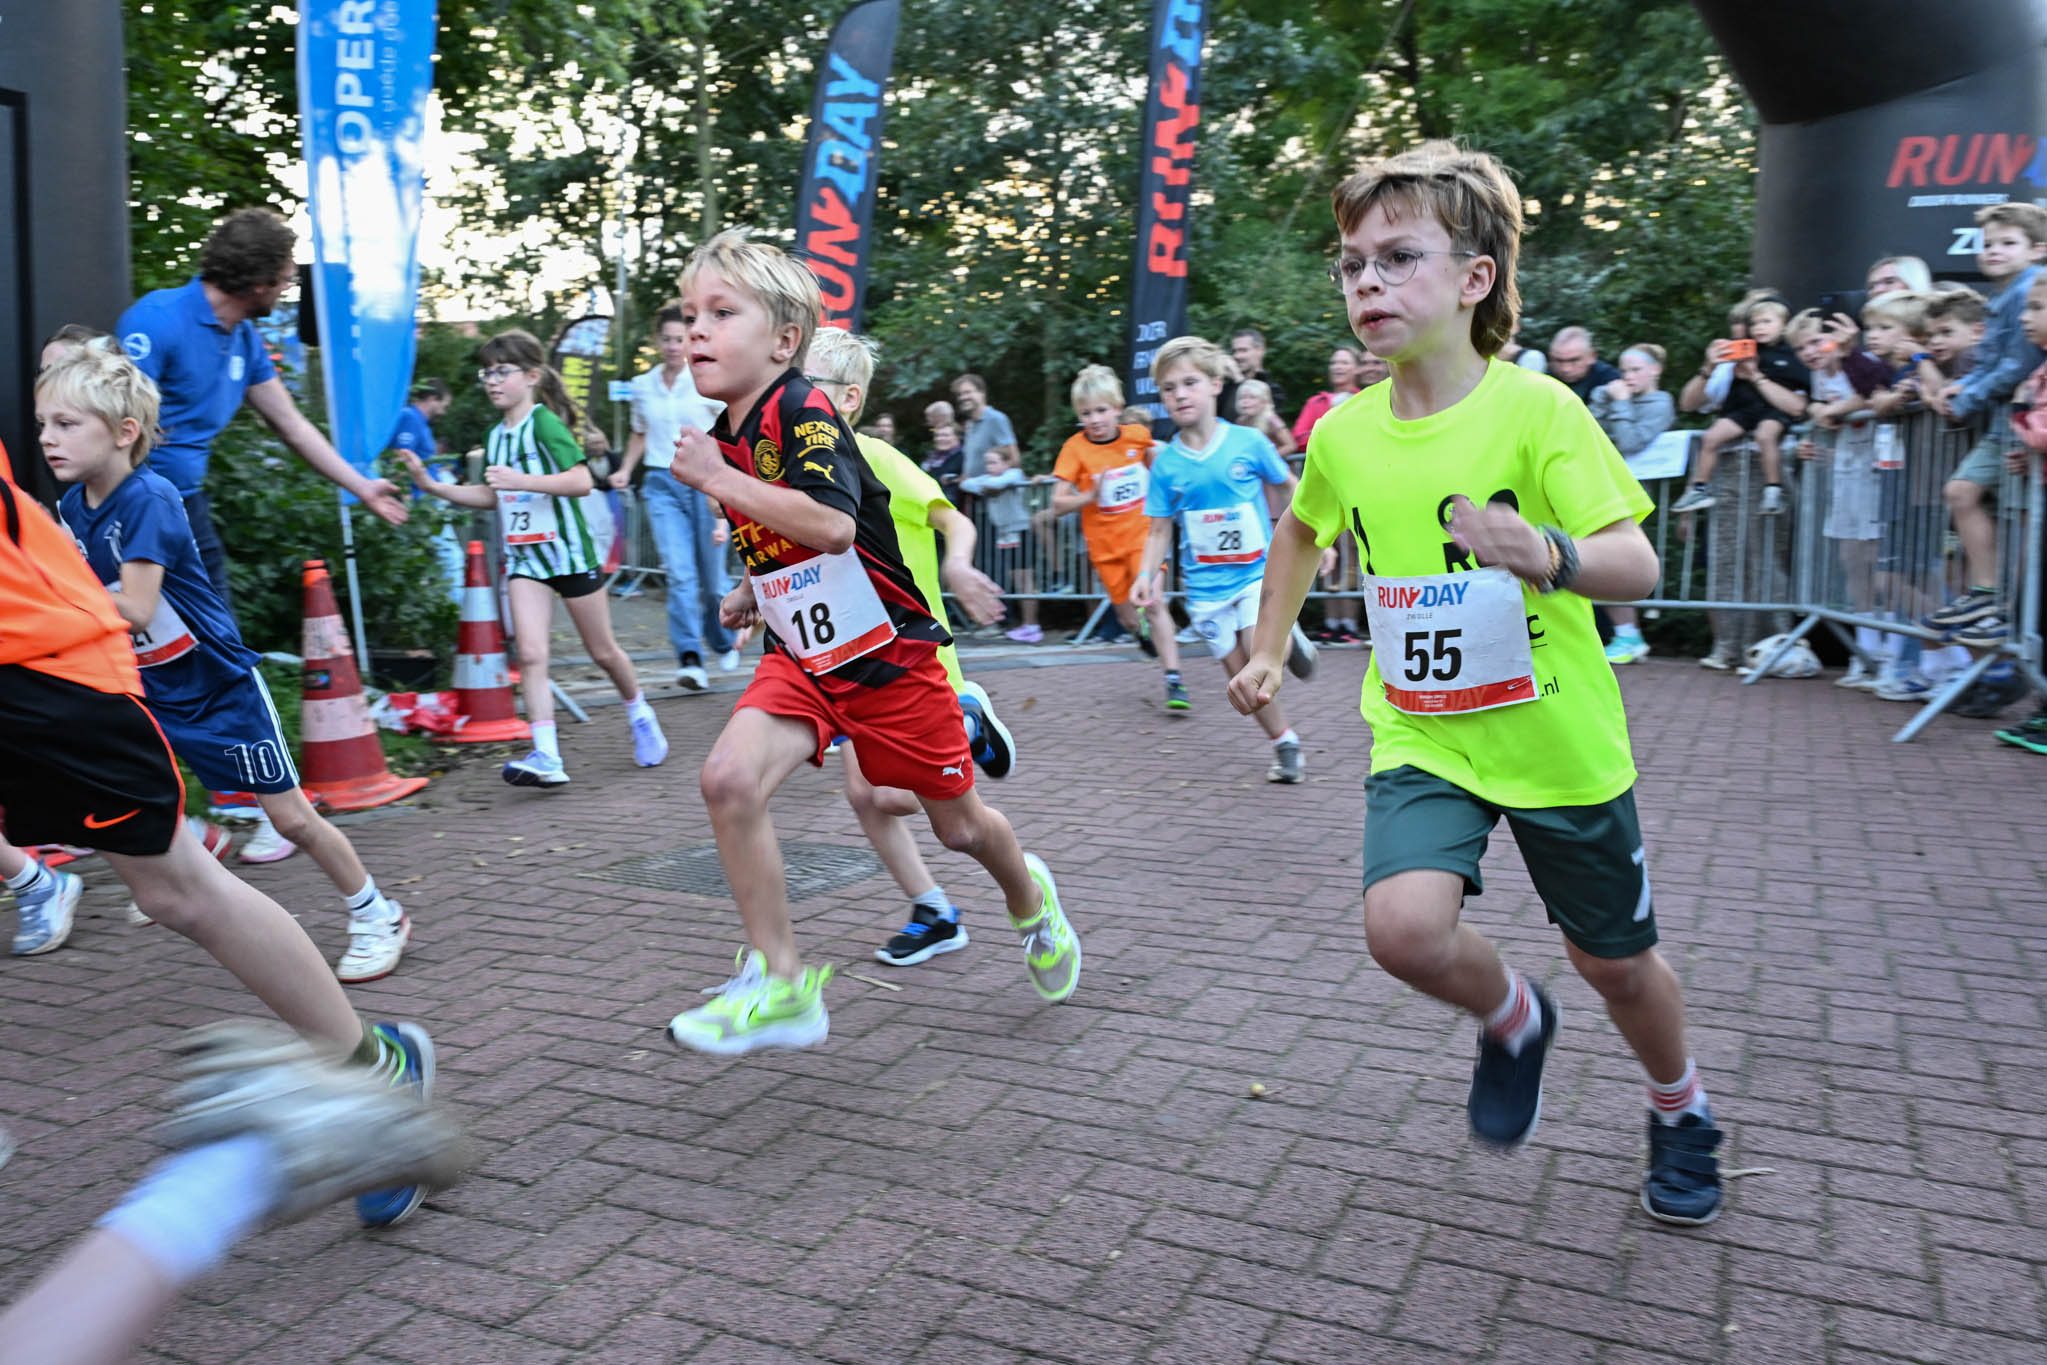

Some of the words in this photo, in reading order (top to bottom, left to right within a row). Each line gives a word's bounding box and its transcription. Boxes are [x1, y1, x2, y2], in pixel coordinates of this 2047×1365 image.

[793, 421, 839, 440] NEXEN
[804, 432, 836, 448] TIRE
[510, 511, 530, 531] 73
[1218, 530, 1241, 551] 28
[791, 602, 835, 650] 18
[1404, 628, 1462, 682] 55
[224, 739, 285, 784] 10
